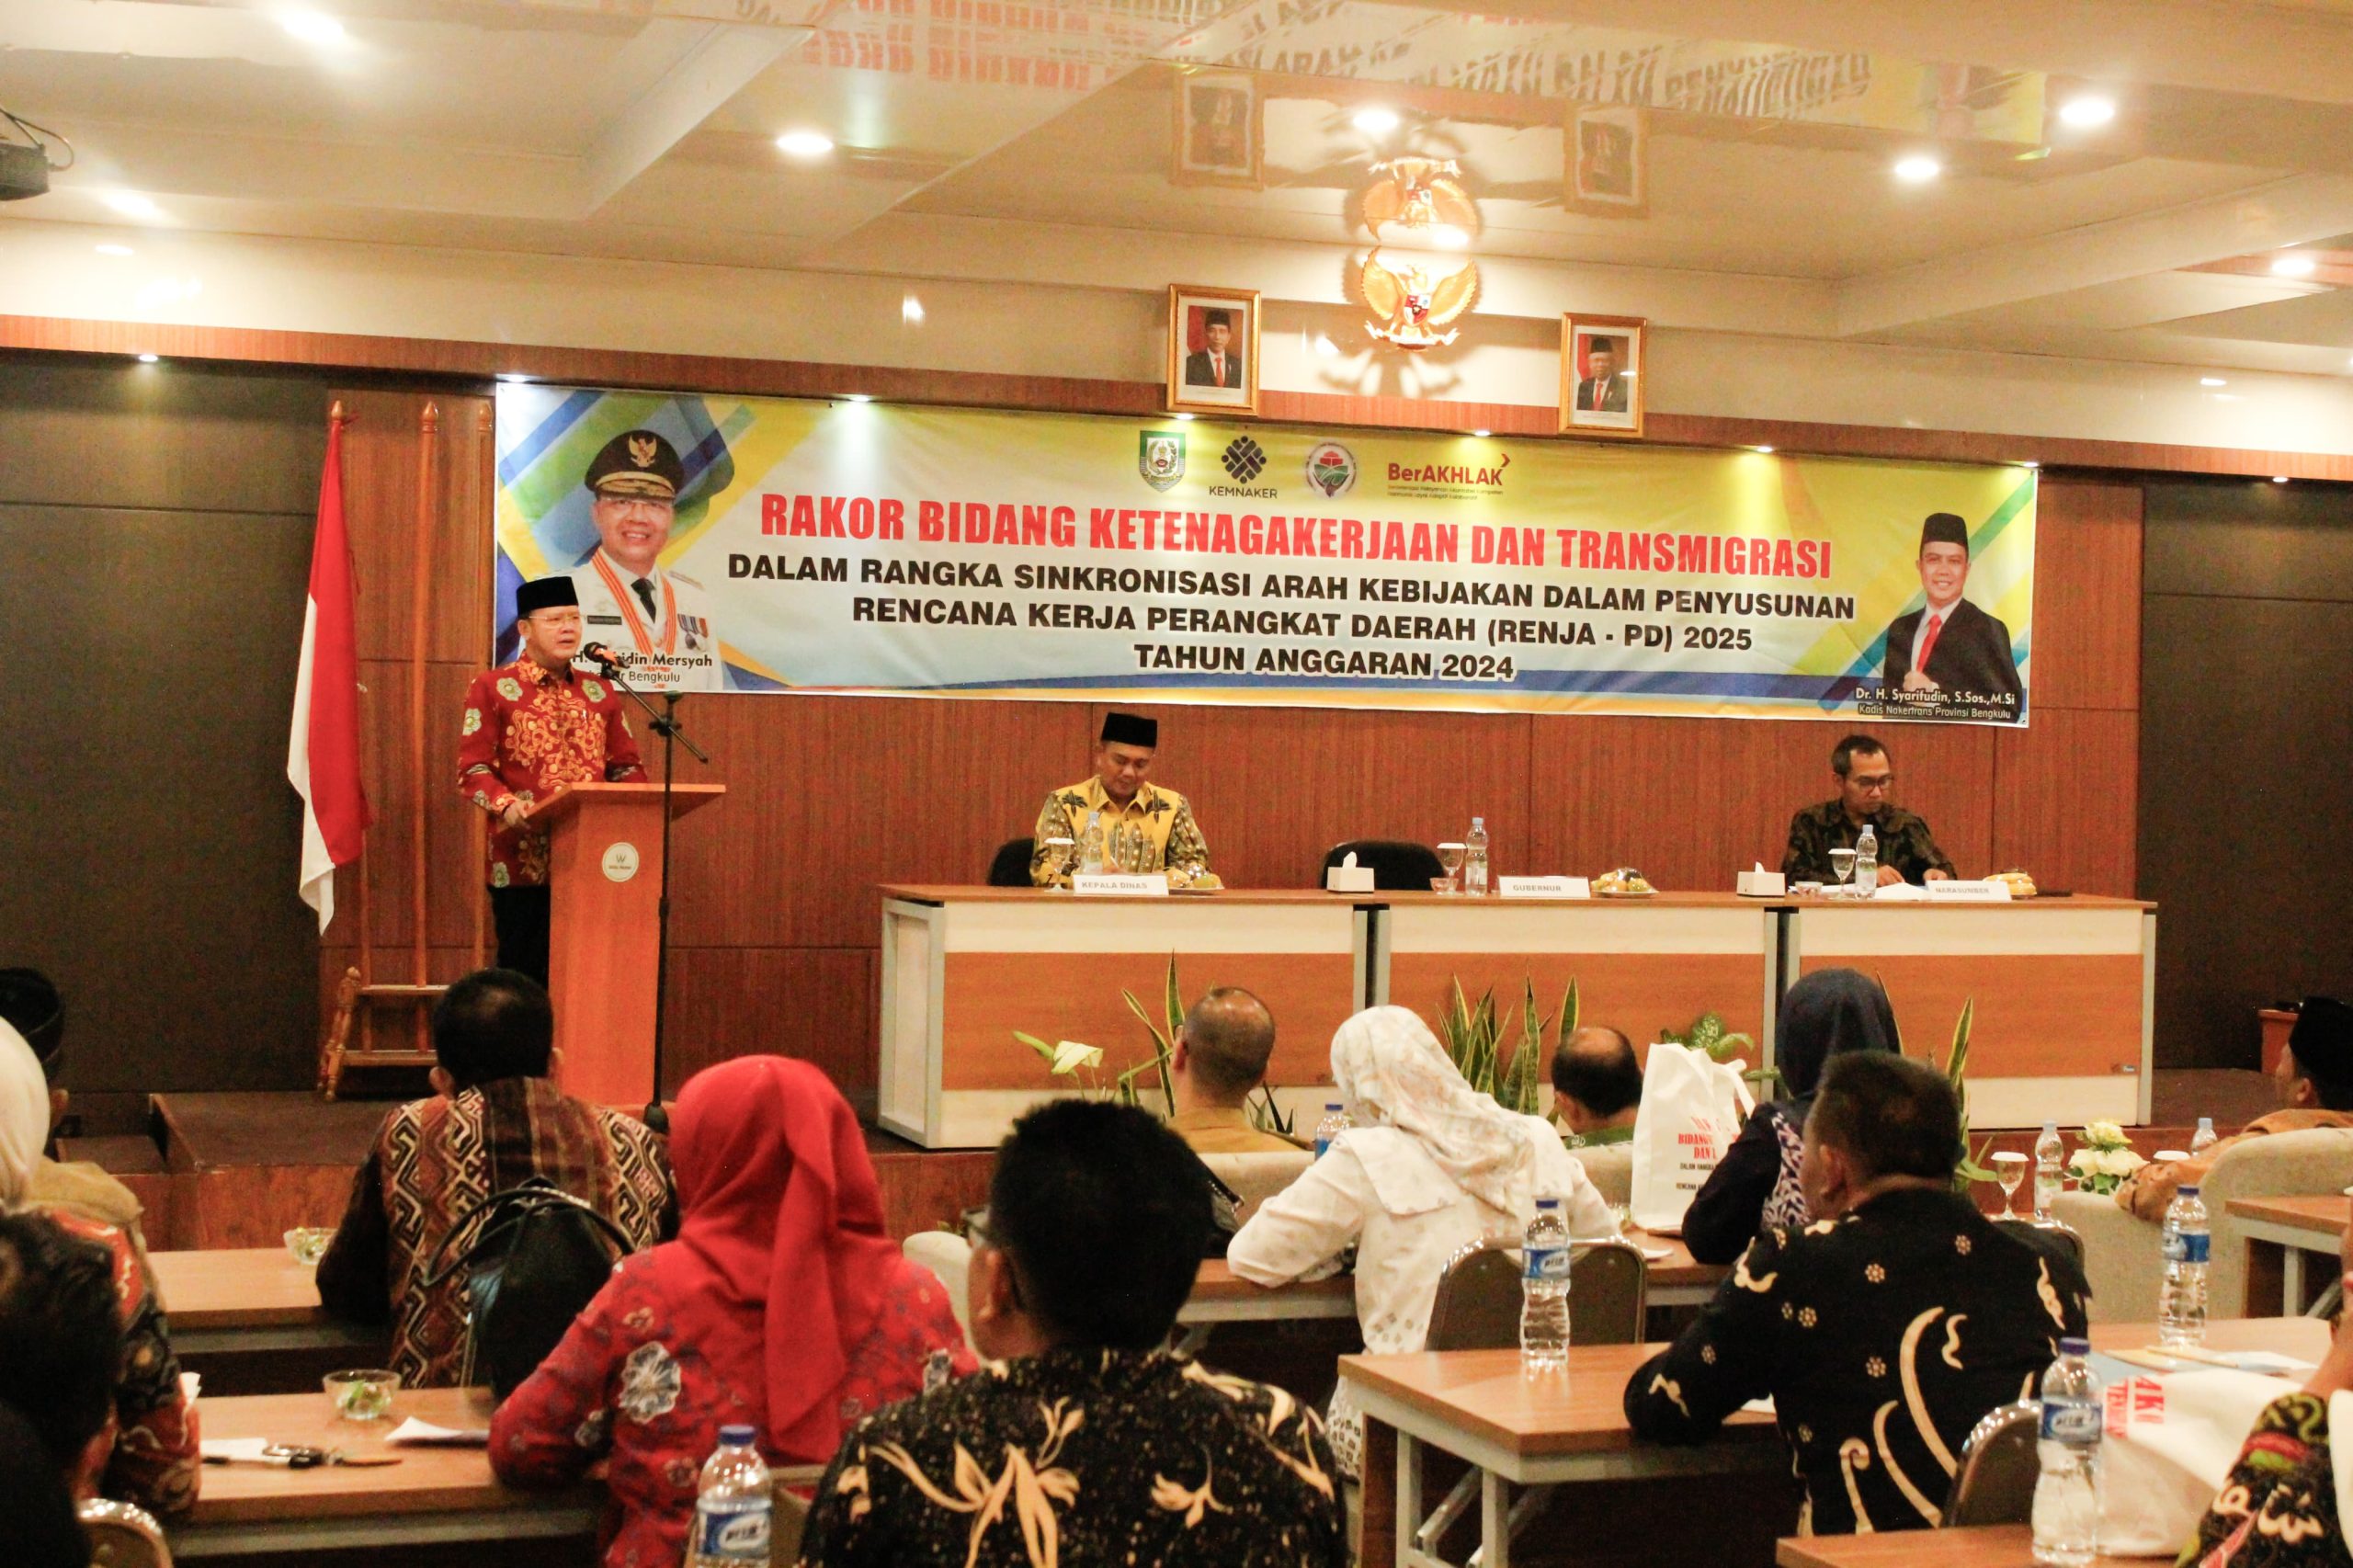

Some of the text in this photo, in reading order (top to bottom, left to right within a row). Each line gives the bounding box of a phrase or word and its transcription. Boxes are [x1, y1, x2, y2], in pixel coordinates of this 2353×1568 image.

[1388, 462, 1504, 486] BerAKHLAK
[1209, 485, 1278, 499] KEMNAKER
[761, 494, 1832, 579] RAKOR BIDANG KETENAGAKERJAAN DAN TRANSMIGRASI
[728, 553, 1854, 619] DALAM RANGKA SINKRONISASI ARAH KEBIJAKAN DALAM PENYUSUNAN
[853, 597, 1017, 626] RENCANA
[1028, 603, 1136, 631] KERJA
[1146, 607, 1341, 636] PERANGKAT
[1351, 614, 1476, 642] DAERAH
[1487, 618, 1597, 646] (RENJA
[1624, 624, 1673, 653] PD)
[1683, 626, 1753, 651] 2025
[653, 653, 712, 669] Mersyah
[1133, 643, 1514, 679] TAHUN ANGGARAN 2024
[629, 670, 680, 686] Bengkulu
[1855, 687, 1871, 699] Dr.
[1875, 687, 1889, 700] H.
[1892, 688, 1951, 704] Syarifudin,
[1859, 703, 2011, 720] Kadis Nakertrans Provinsi Bengkulu
[616, 852, 627, 863] W
[1082, 881, 1148, 890] KEPALA DINAS
